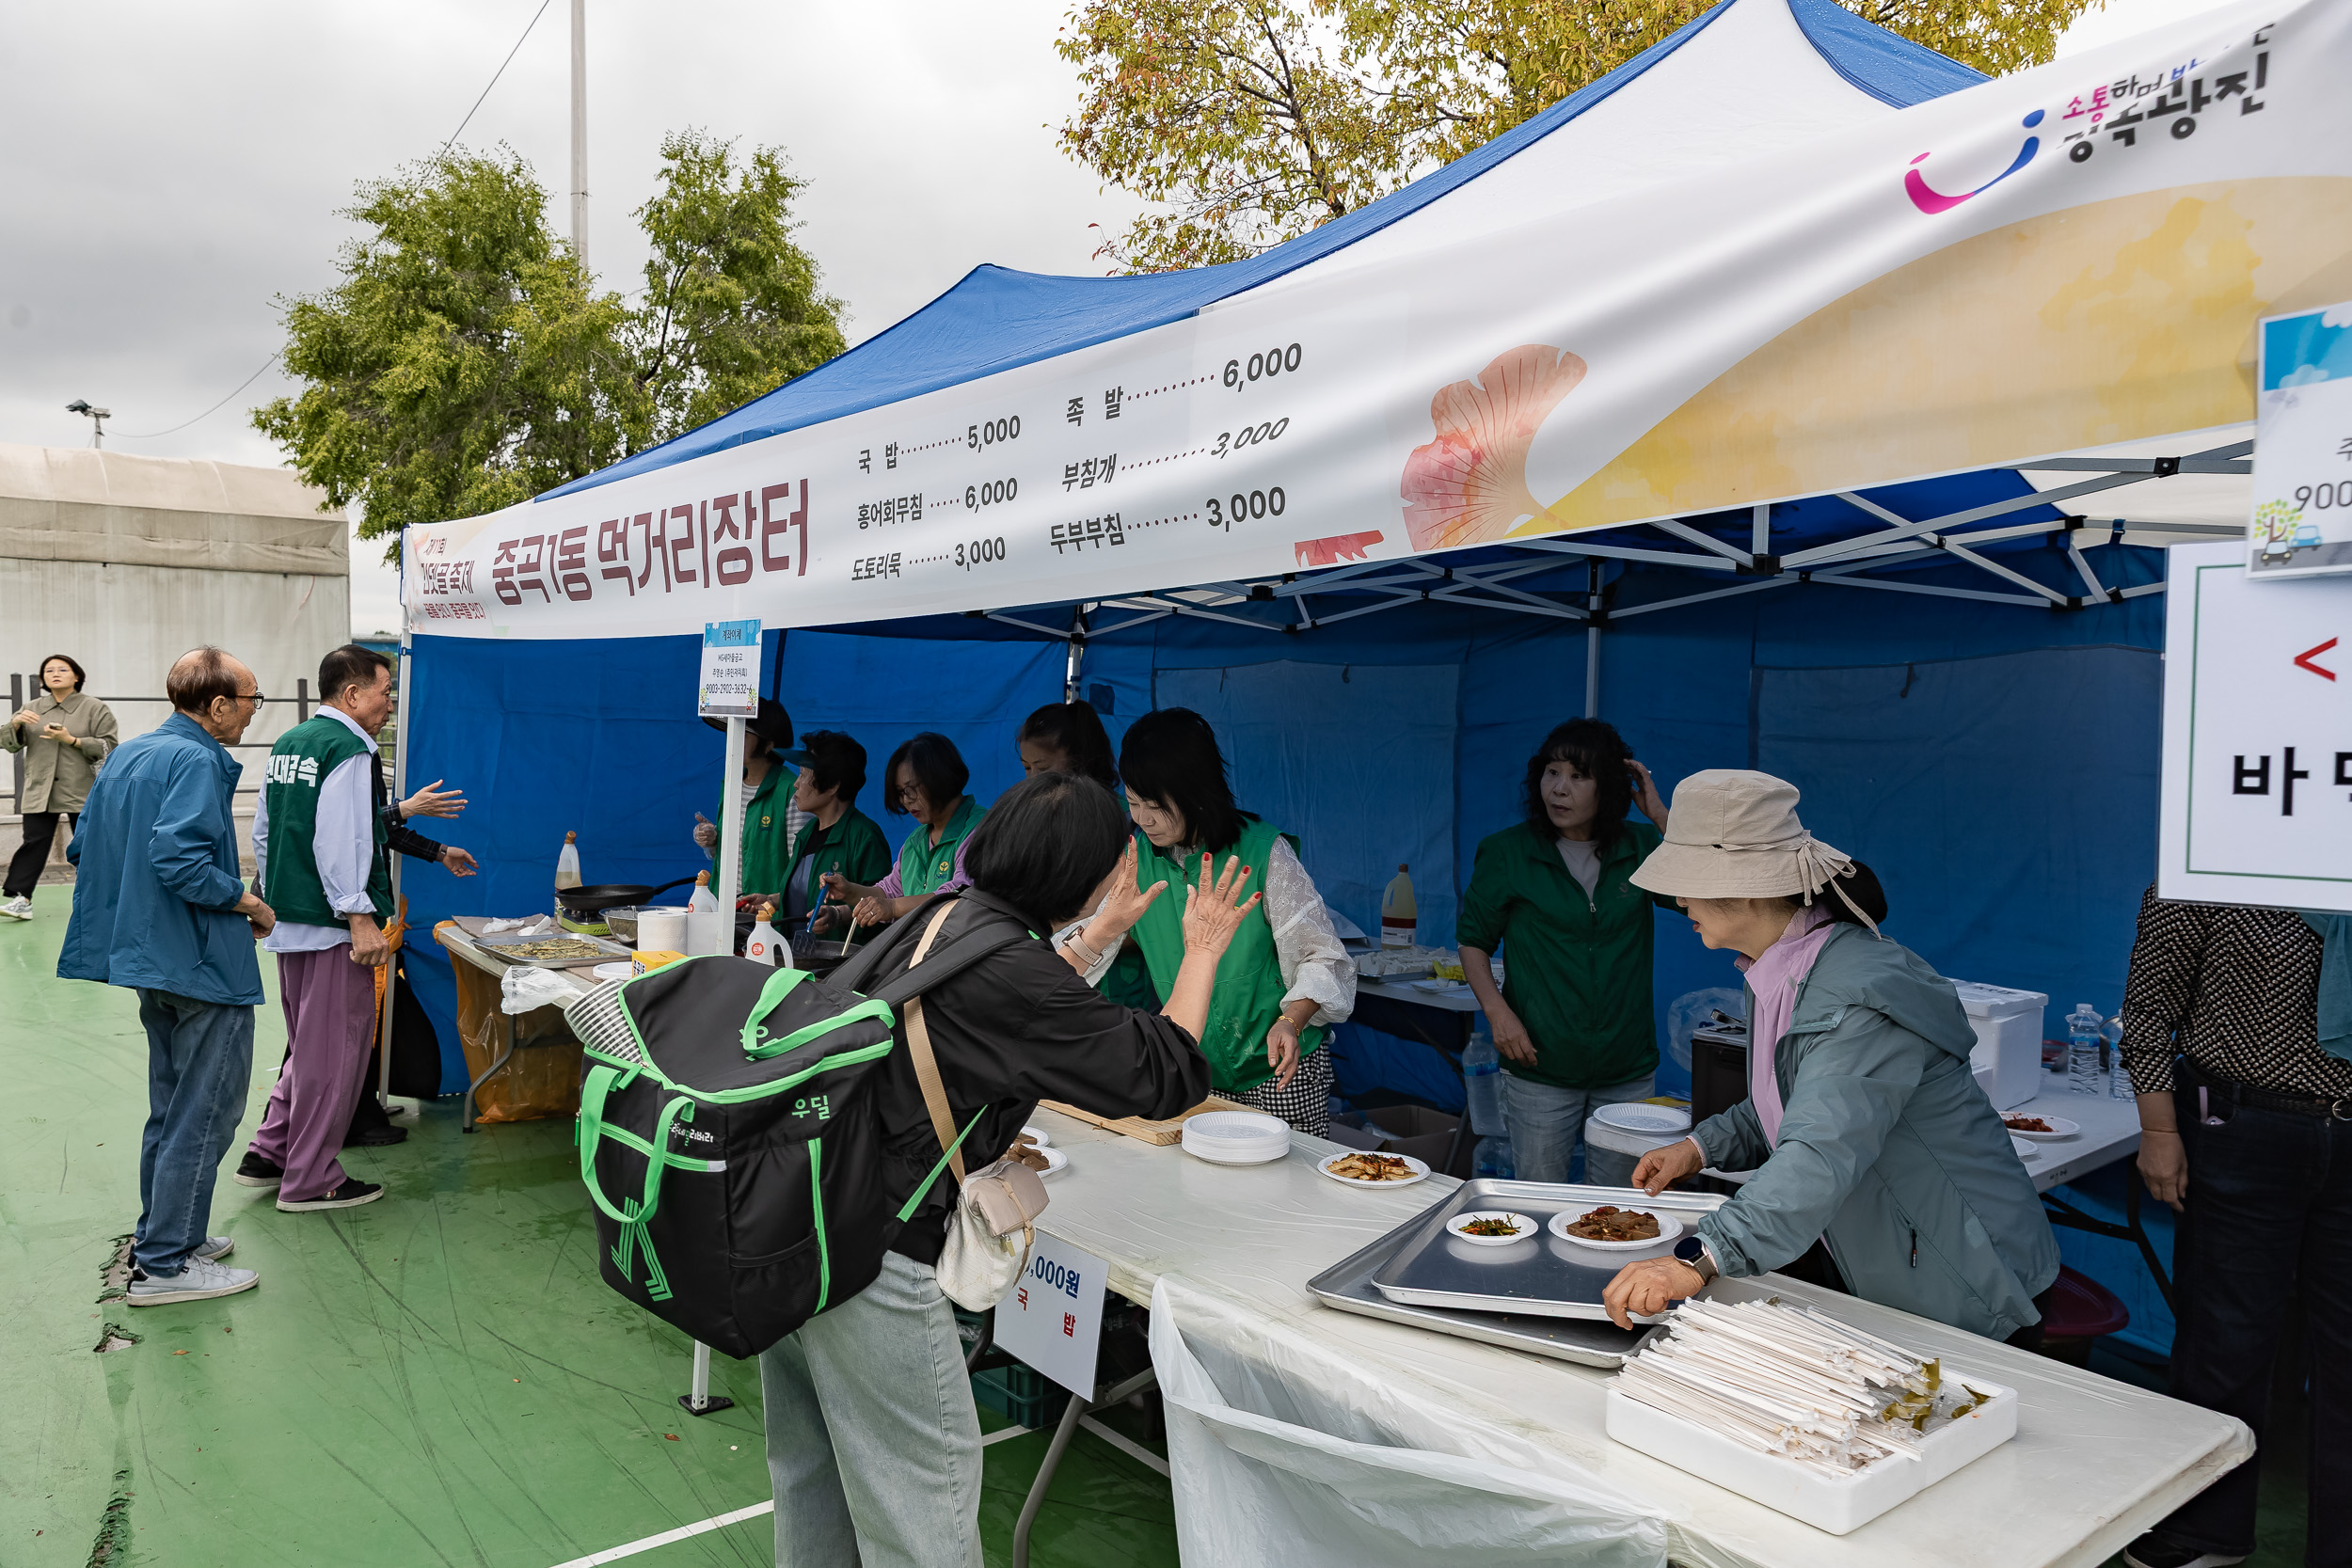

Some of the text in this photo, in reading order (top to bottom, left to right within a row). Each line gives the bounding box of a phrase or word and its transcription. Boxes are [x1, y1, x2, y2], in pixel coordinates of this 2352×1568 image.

[1066, 342, 1302, 428] 족 발 6,000
[858, 414, 1021, 475] 국 밥 5,000
[1061, 417, 1290, 493] 부침개 3,000
[857, 477, 1018, 531] 홍어회무침 6,000
[1049, 485, 1286, 555] 두부부침 3,000
[492, 478, 809, 607] 중곡1동 먹거리장터
[850, 536, 1006, 582] 도토리묵 3,000
[450, 560, 475, 594] 축제
[722, 628, 741, 641] 계좌이체
[791, 1095, 831, 1120] 우딜
[1025, 1255, 1081, 1300] ,000원
[1017, 1286, 1076, 1338] 국 밥
